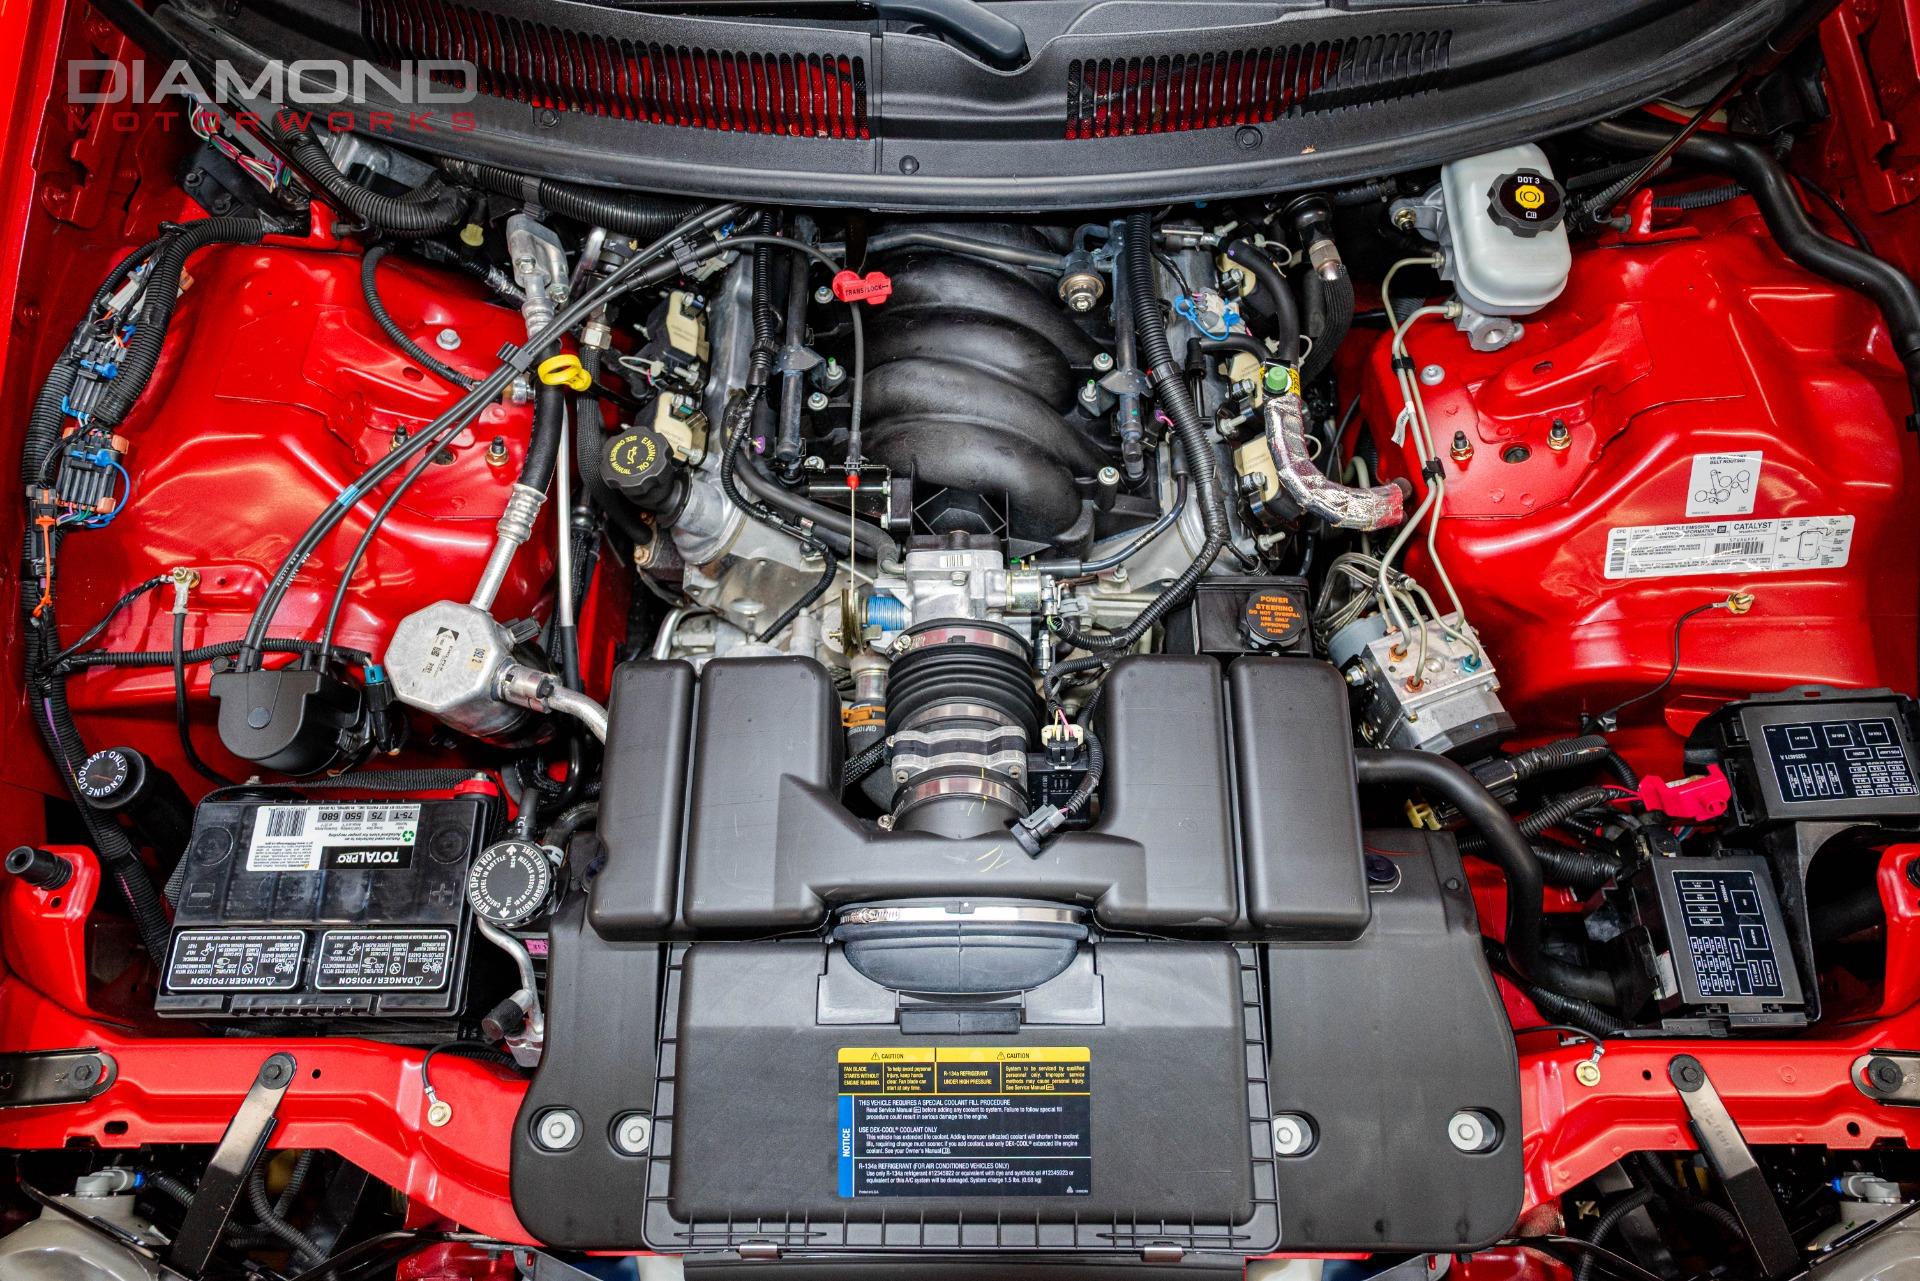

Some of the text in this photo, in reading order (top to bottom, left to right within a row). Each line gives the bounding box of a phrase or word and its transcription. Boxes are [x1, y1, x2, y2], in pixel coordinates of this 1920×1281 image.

[636, 437, 656, 471] ENGINE OIL
[612, 461, 632, 474] MANUAL
[1734, 522, 1772, 530] CATALYST
[1256, 604, 1293, 612] STEERING
[78, 750, 126, 796] ENGINE COOLANT ONLY
[322, 812, 339, 820] 680
[522, 846, 538, 862] TUBE
[487, 855, 506, 870] BOTTLE
[518, 856, 535, 874] SYSTEM
[534, 858, 544, 873] VENT
[471, 850, 496, 913] NEVER OPEN HOT
[525, 874, 535, 895] CLOSED
[519, 894, 526, 902] LB
[532, 879, 545, 902] ARROW
[484, 895, 501, 908] CHECK
[516, 900, 534, 916] ALIGN
